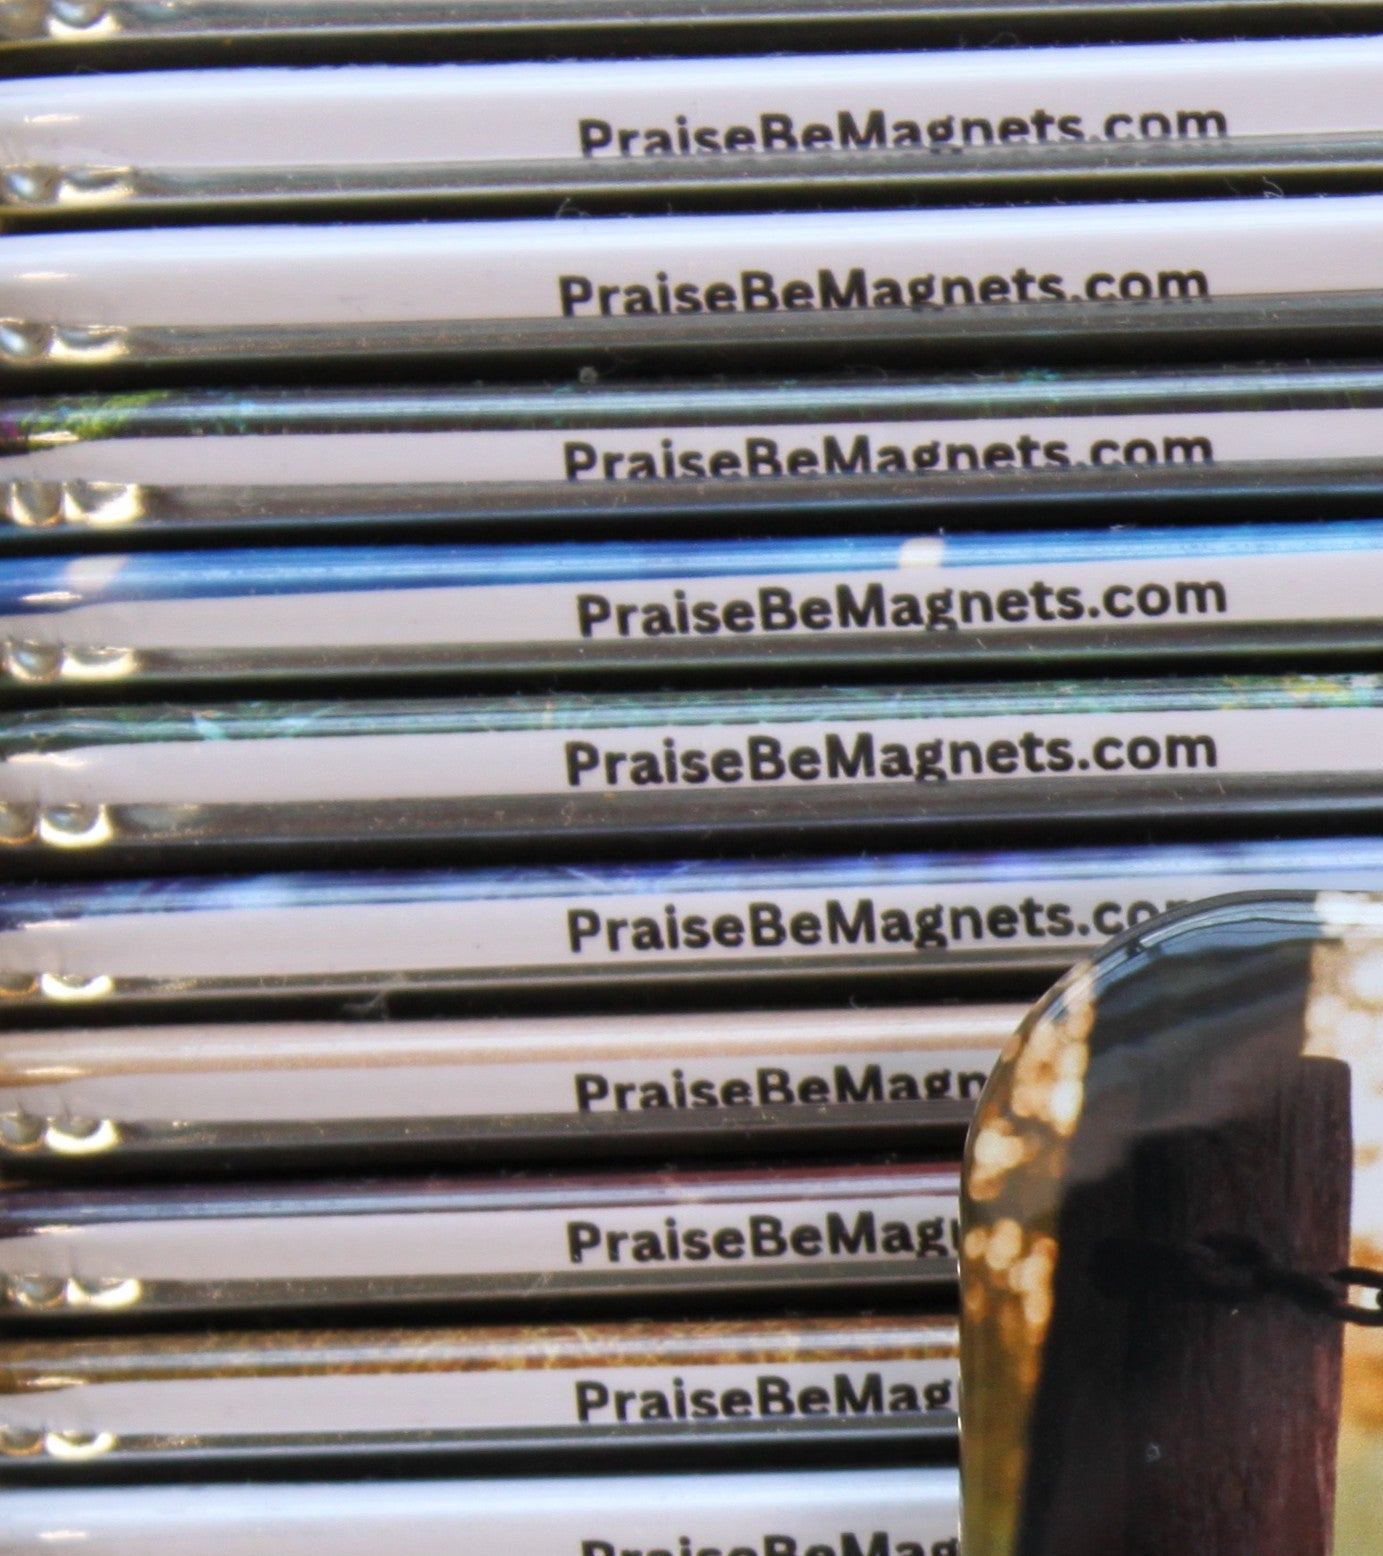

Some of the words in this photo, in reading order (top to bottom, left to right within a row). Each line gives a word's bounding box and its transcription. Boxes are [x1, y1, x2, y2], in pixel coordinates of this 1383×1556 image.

[557, 266, 1210, 317] PraiseBeMagnets.com
[563, 433, 1214, 482] PraiseBeMagnets.com
[575, 580, 1228, 637] PraiseBeMagnets.com
[564, 731, 1218, 786] PraiseBeMagnets.com
[574, 1062, 987, 1113] PraiseBeMagn
[565, 1209, 960, 1264] PraiseBeMag
[574, 1372, 953, 1424] PraiseBeMag
